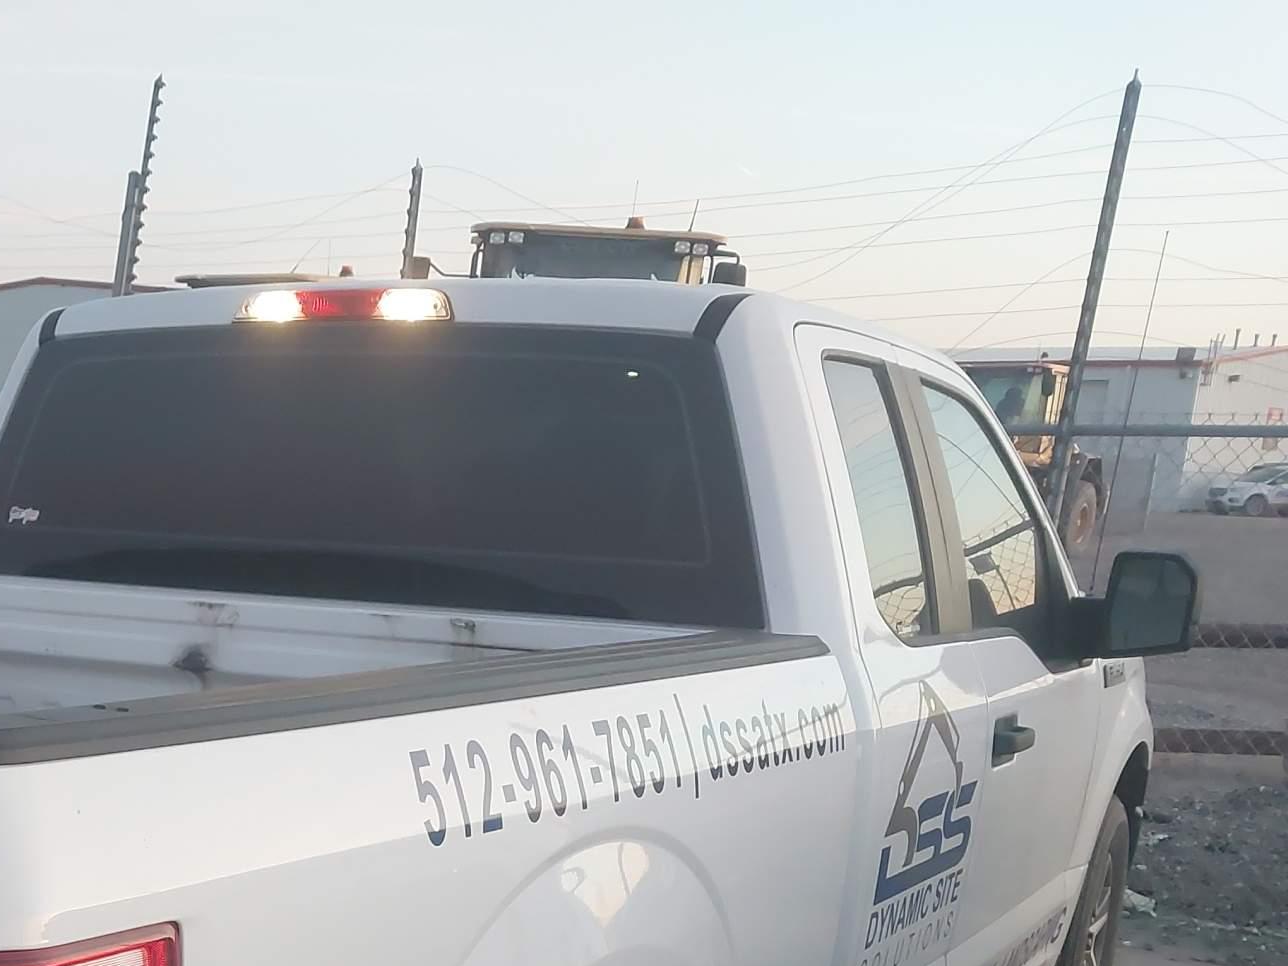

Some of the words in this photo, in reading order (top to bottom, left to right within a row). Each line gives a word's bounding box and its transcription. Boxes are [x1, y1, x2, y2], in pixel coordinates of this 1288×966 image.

[409, 709, 681, 846] 512-961-7851
[702, 698, 846, 780] dssatx.com
[865, 884, 933, 950] DYNAMIC
[932, 868, 962, 912] SITE
